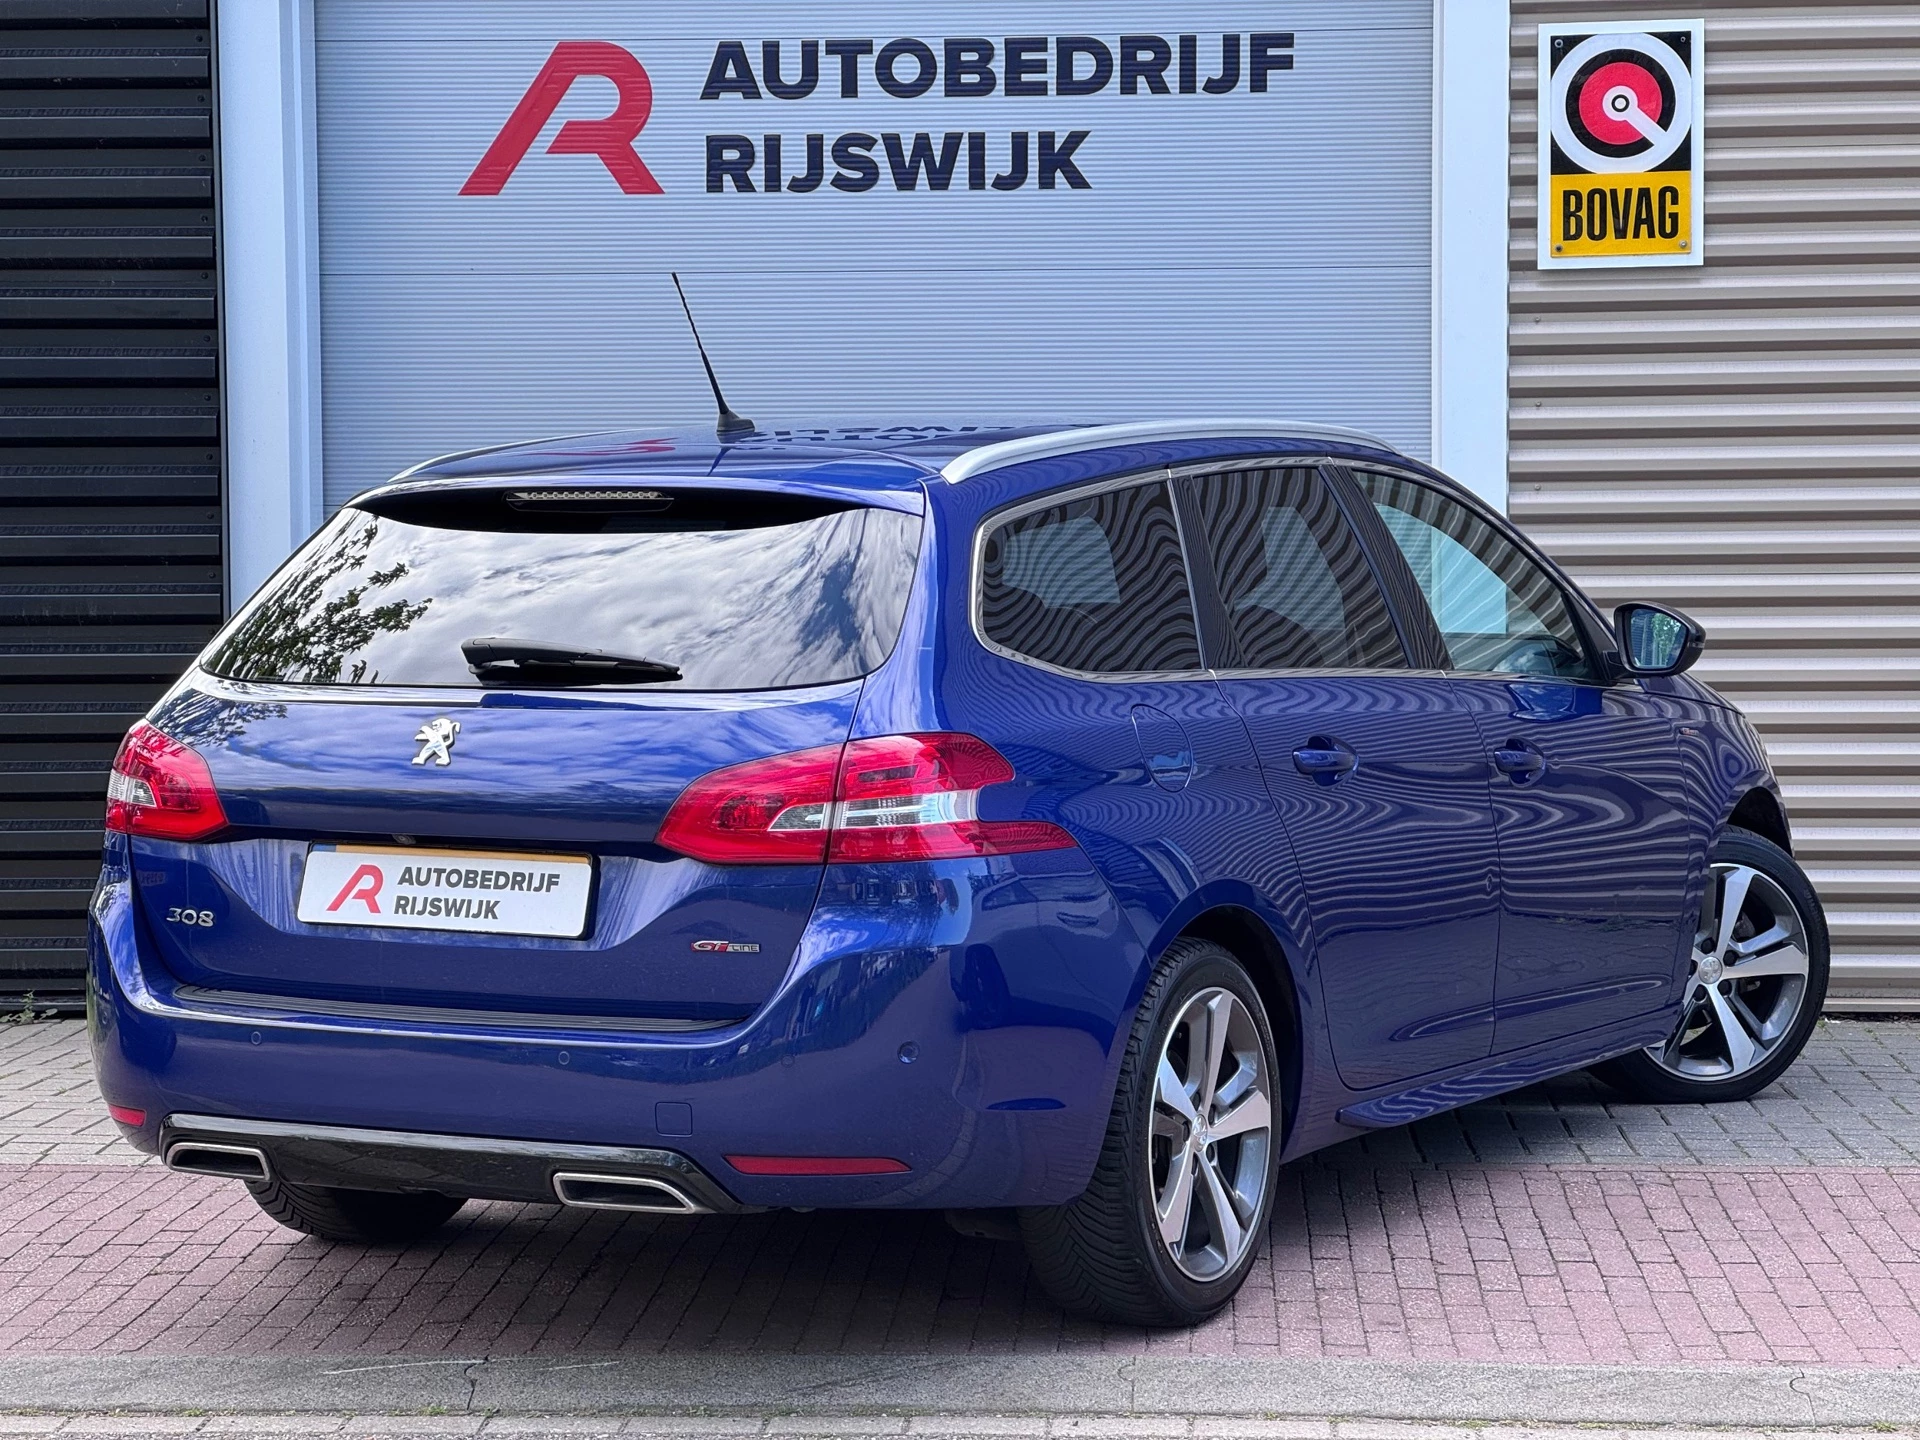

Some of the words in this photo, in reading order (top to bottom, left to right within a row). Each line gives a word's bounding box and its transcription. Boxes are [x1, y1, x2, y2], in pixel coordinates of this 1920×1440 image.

[700, 33, 1294, 101] AUTOBEDRIJF
[706, 130, 1092, 193] RIJSWIJK
[1562, 186, 1679, 241] BOVAG
[397, 866, 560, 893] AUTOBEDRIJF
[166, 907, 214, 927] 308
[394, 895, 501, 920] RIJSWIJK
